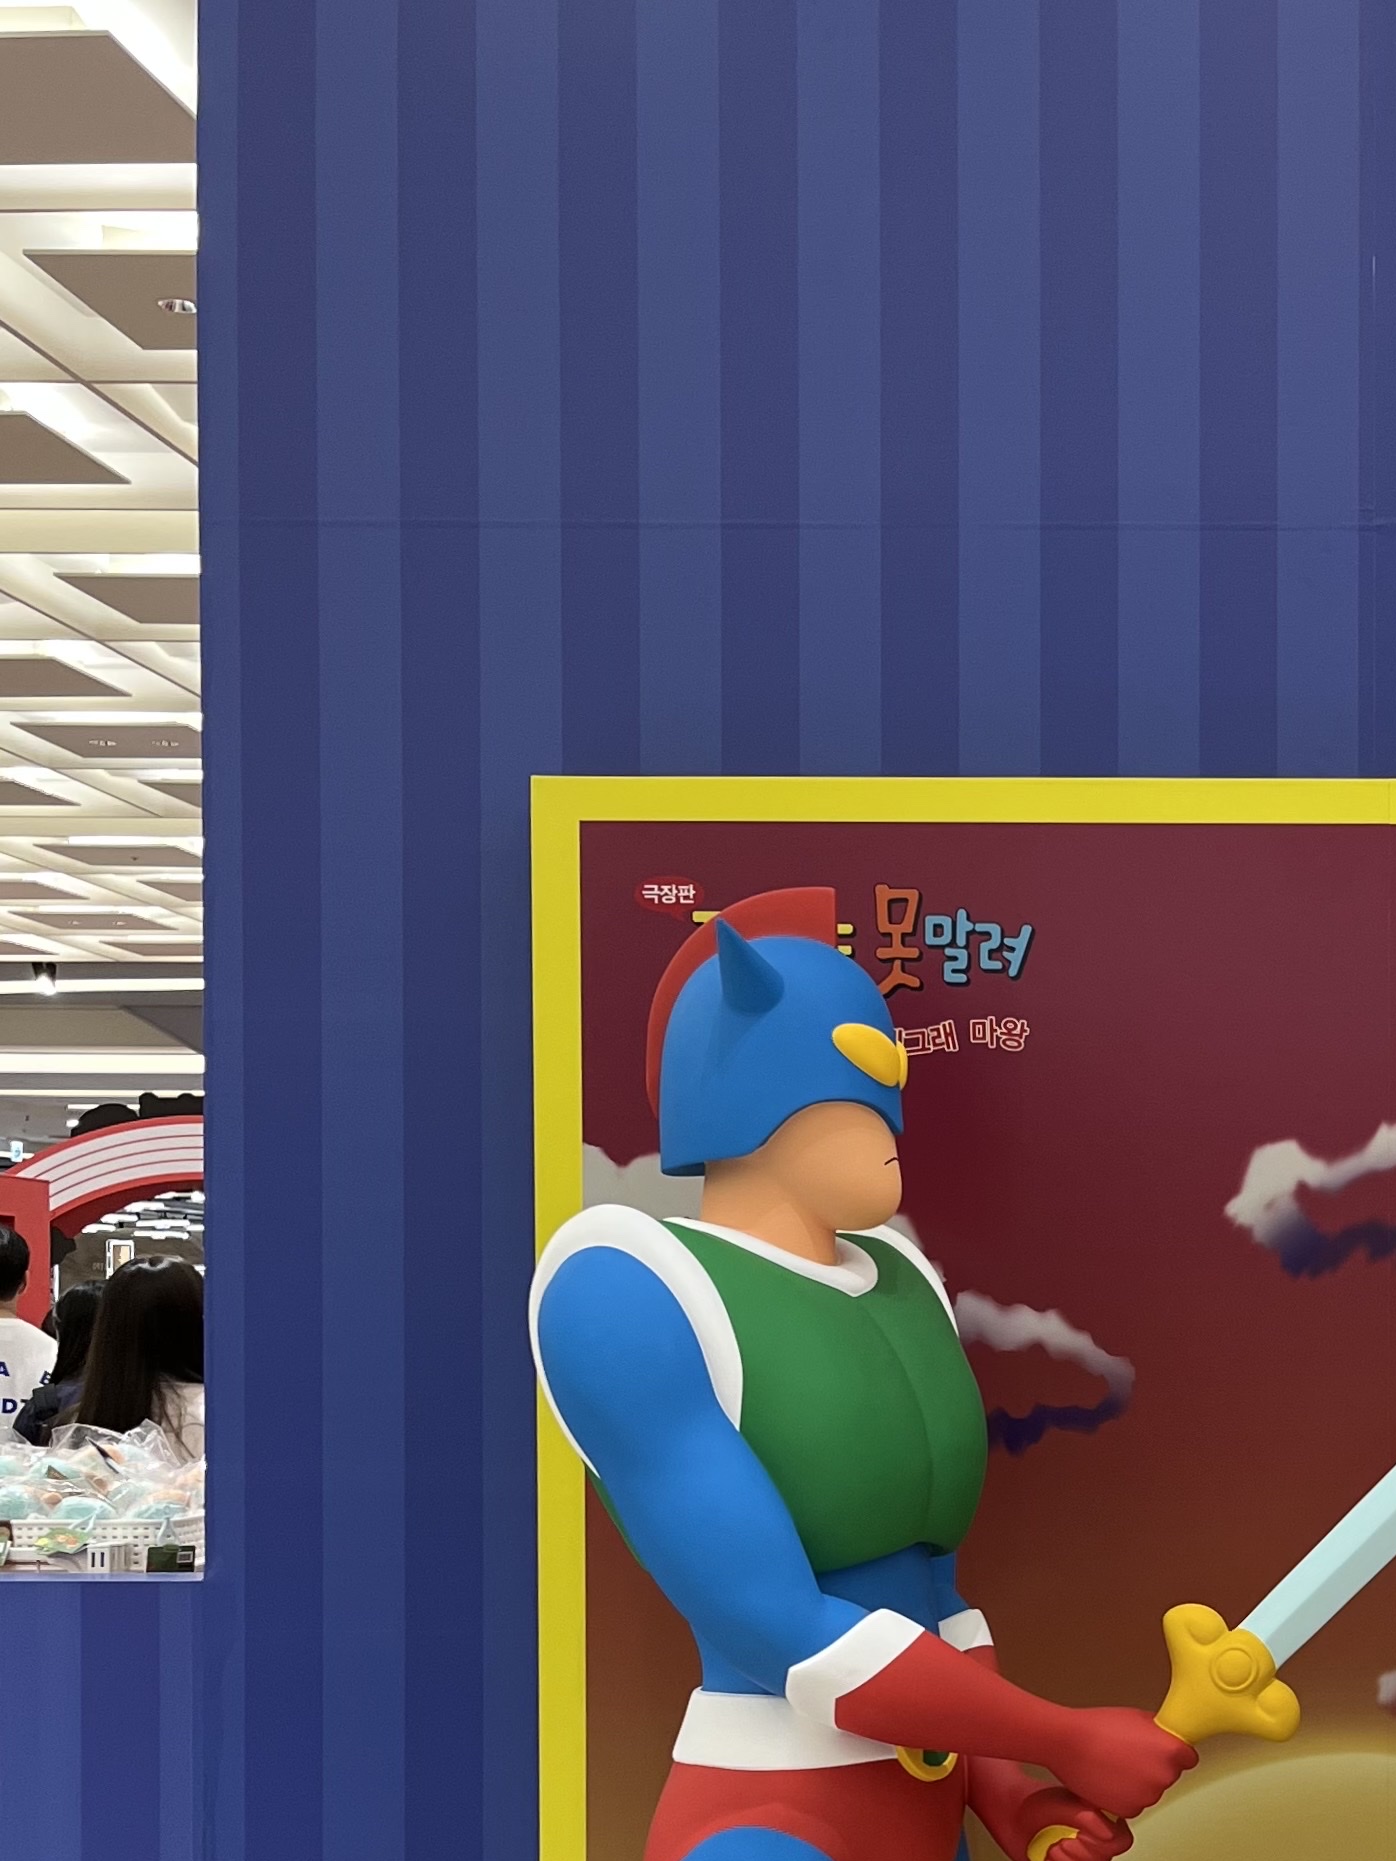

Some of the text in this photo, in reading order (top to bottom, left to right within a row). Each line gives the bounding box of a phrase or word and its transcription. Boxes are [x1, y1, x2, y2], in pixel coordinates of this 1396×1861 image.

[641, 883, 696, 905] 극장판
[874, 884, 1034, 998] 못말려
[894, 1015, 1030, 1056] 그래 마왕
